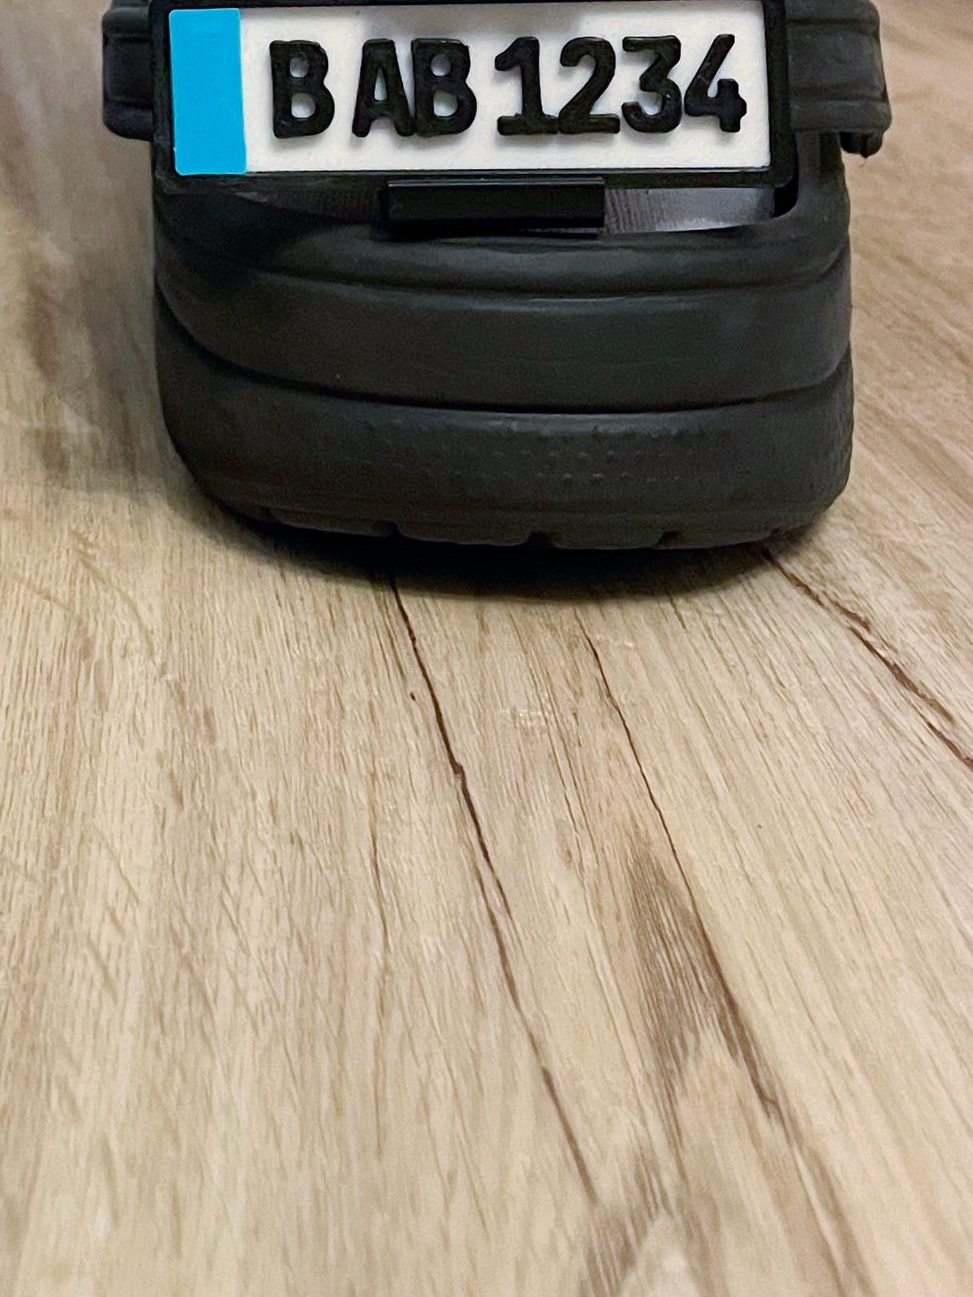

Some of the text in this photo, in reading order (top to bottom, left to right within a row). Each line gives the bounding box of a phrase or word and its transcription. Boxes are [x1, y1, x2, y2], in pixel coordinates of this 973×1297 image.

[268, 33, 748, 139] B AB 1234
